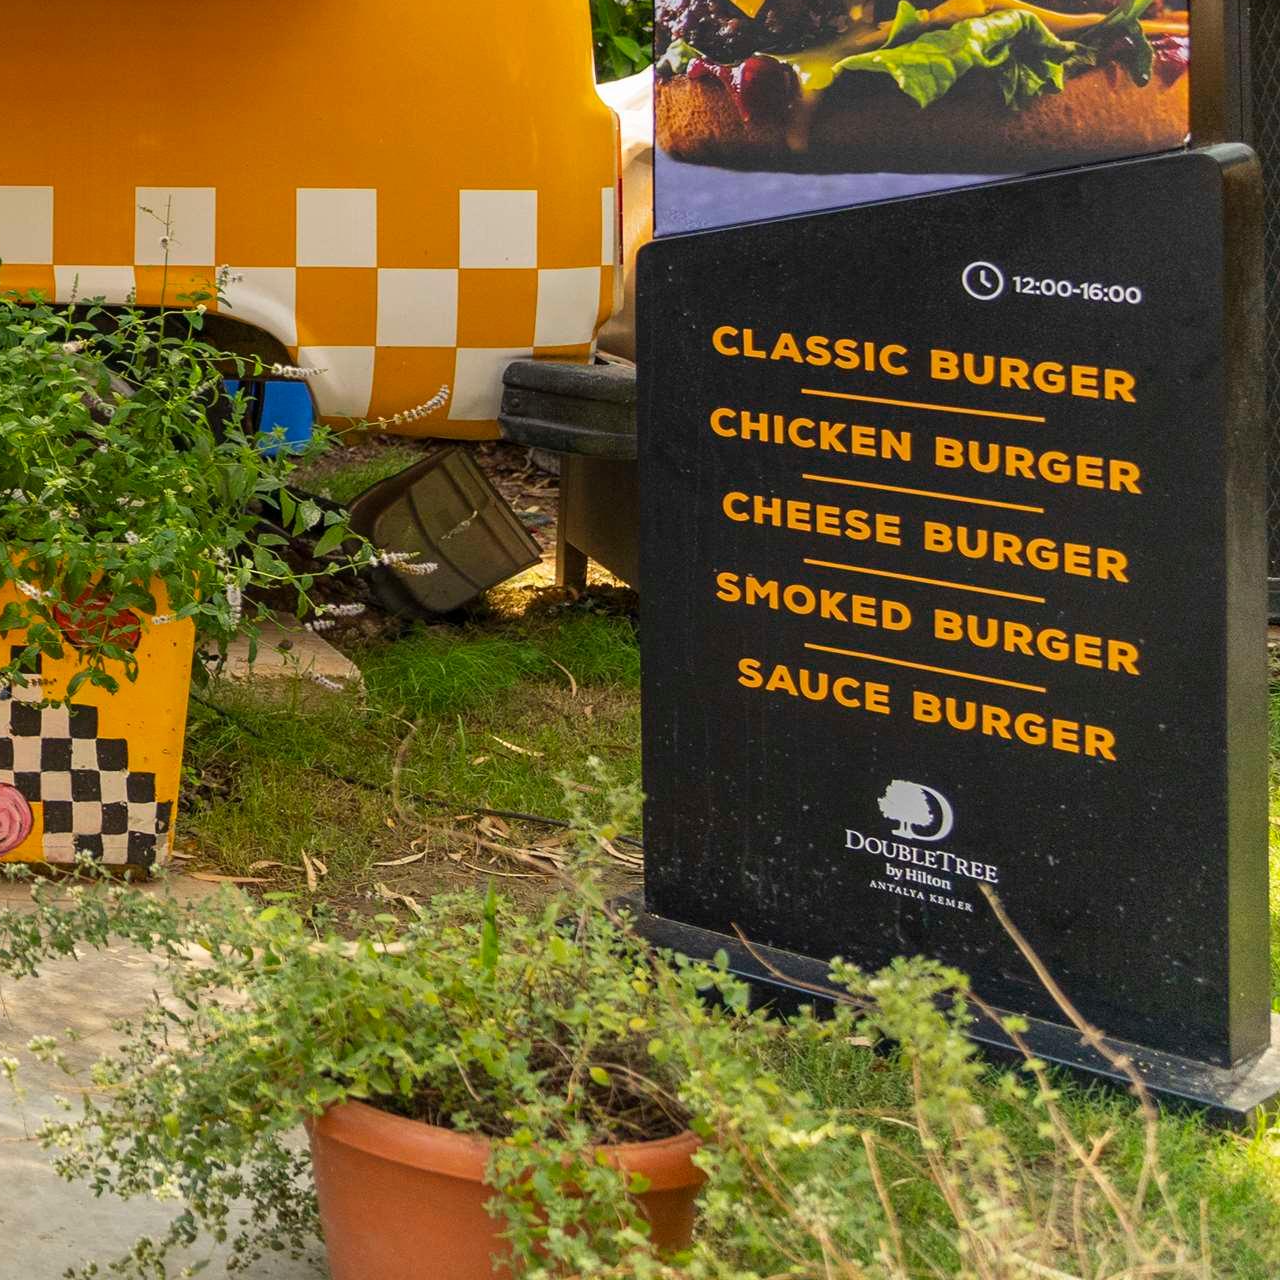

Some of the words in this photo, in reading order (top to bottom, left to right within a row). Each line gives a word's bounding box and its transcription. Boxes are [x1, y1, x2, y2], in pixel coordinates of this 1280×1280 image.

[1012, 275, 1142, 305] 12:00-16:00
[711, 325, 909, 376] CLASSIC
[930, 348, 1137, 403] BURGER
[710, 407, 912, 461] CHICKEN
[935, 436, 1142, 494] BURGER
[722, 491, 901, 546] CHEESE
[924, 521, 1129, 583] BURGER
[715, 572, 912, 632] SMOKED
[934, 608, 1140, 676] BURGER
[737, 657, 891, 714] SAUCE
[913, 690, 1117, 761] BURGER
[869, 880, 925, 901] ANTALYA
[929, 894, 973, 913] KEMER
[886, 863, 903, 880] by
[905, 868, 952, 890] Hilton
